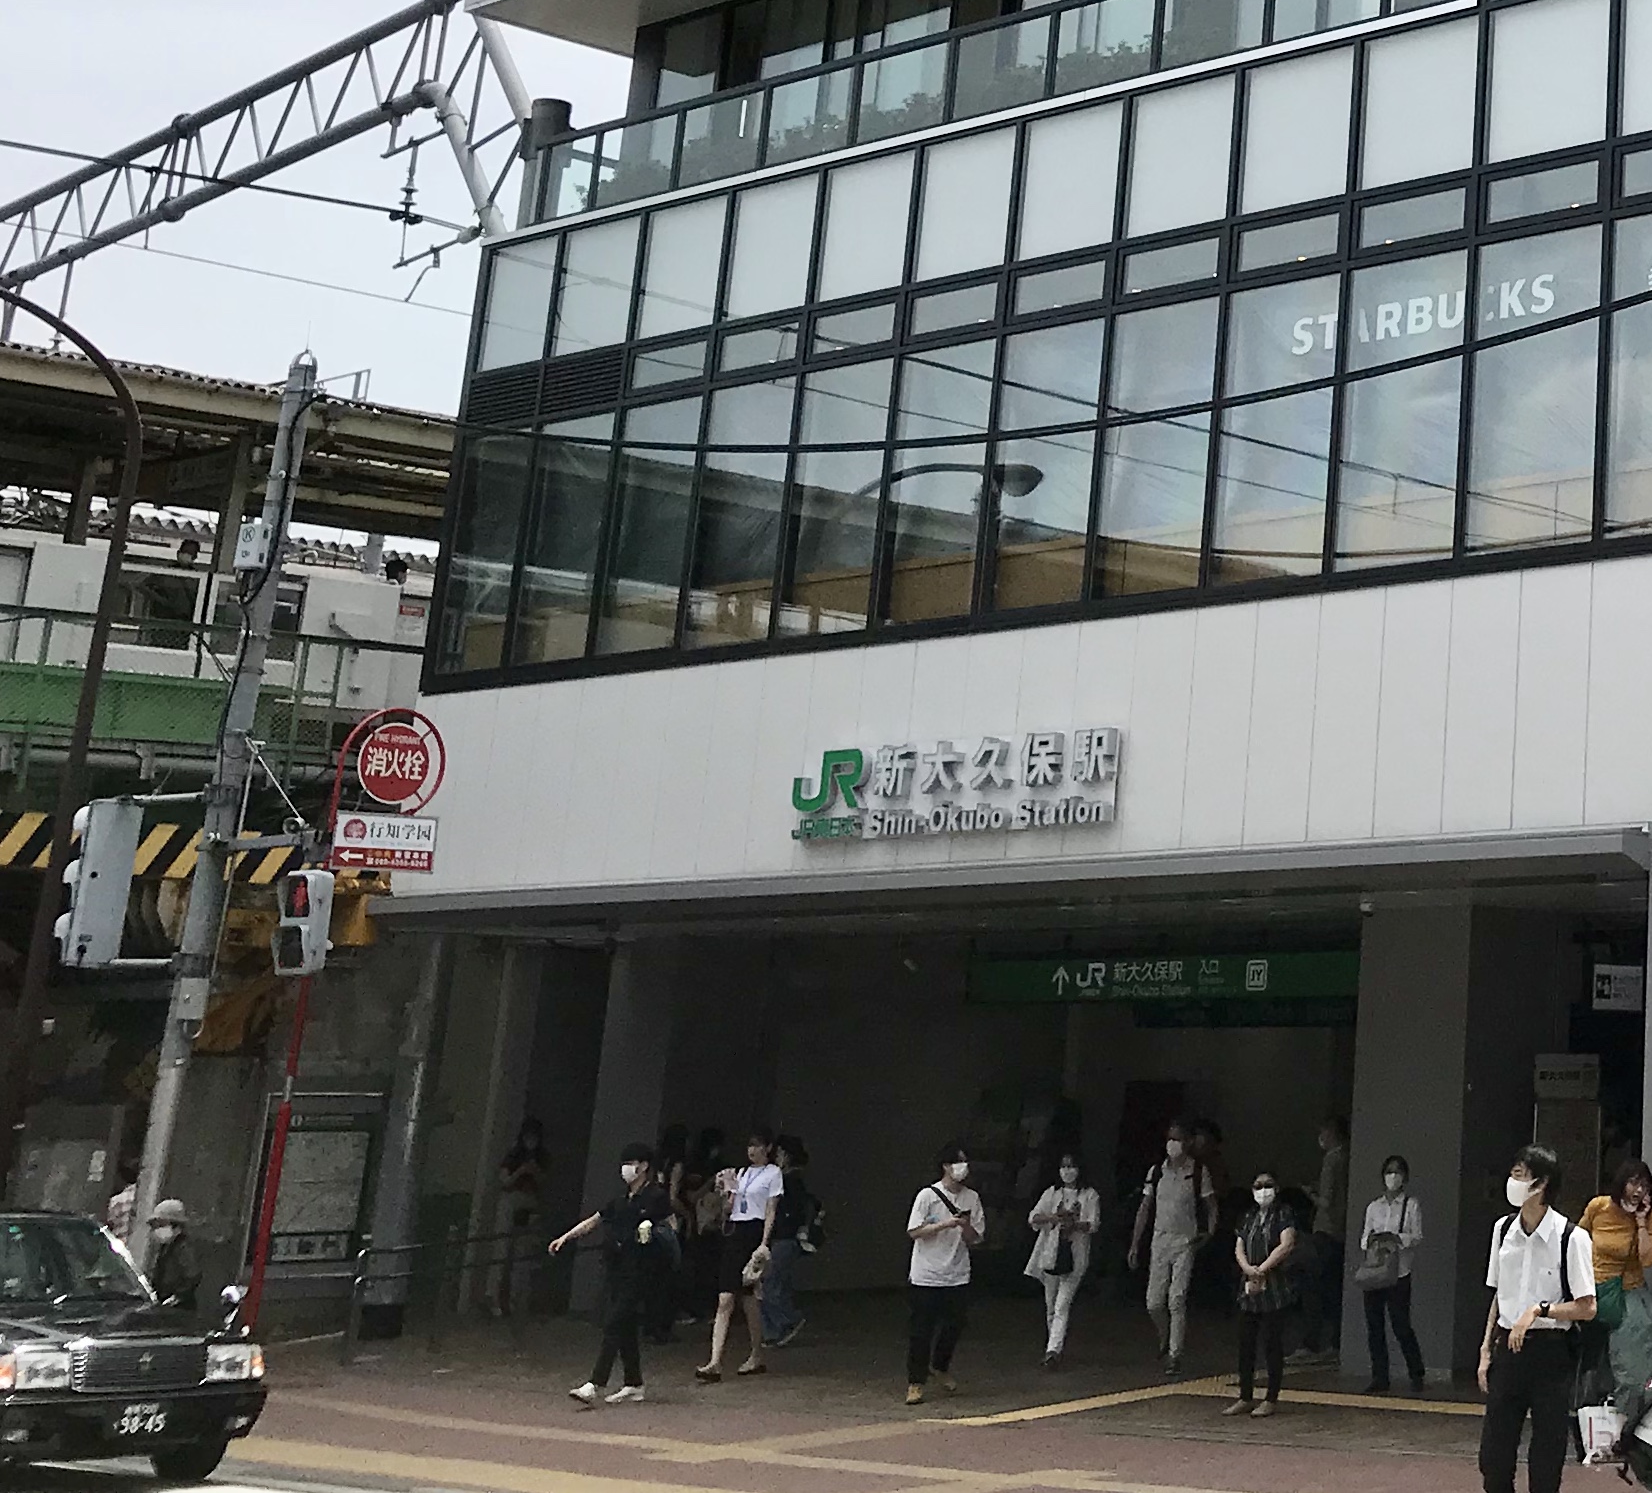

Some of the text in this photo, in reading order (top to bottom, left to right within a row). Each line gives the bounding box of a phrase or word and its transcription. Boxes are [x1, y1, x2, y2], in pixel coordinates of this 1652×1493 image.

[1291, 273, 1556, 356] STRBUKS
[364, 746, 426, 781] 消火栓
[792, 748, 864, 813] JR
[873, 727, 1119, 798] 新大久保駅
[868, 796, 1106, 838] Shin-Okubo Station
[1076, 963, 1107, 987] JR
[1112, 961, 1183, 983] 新大久保駅
[1199, 960, 1220, 974] 入口
